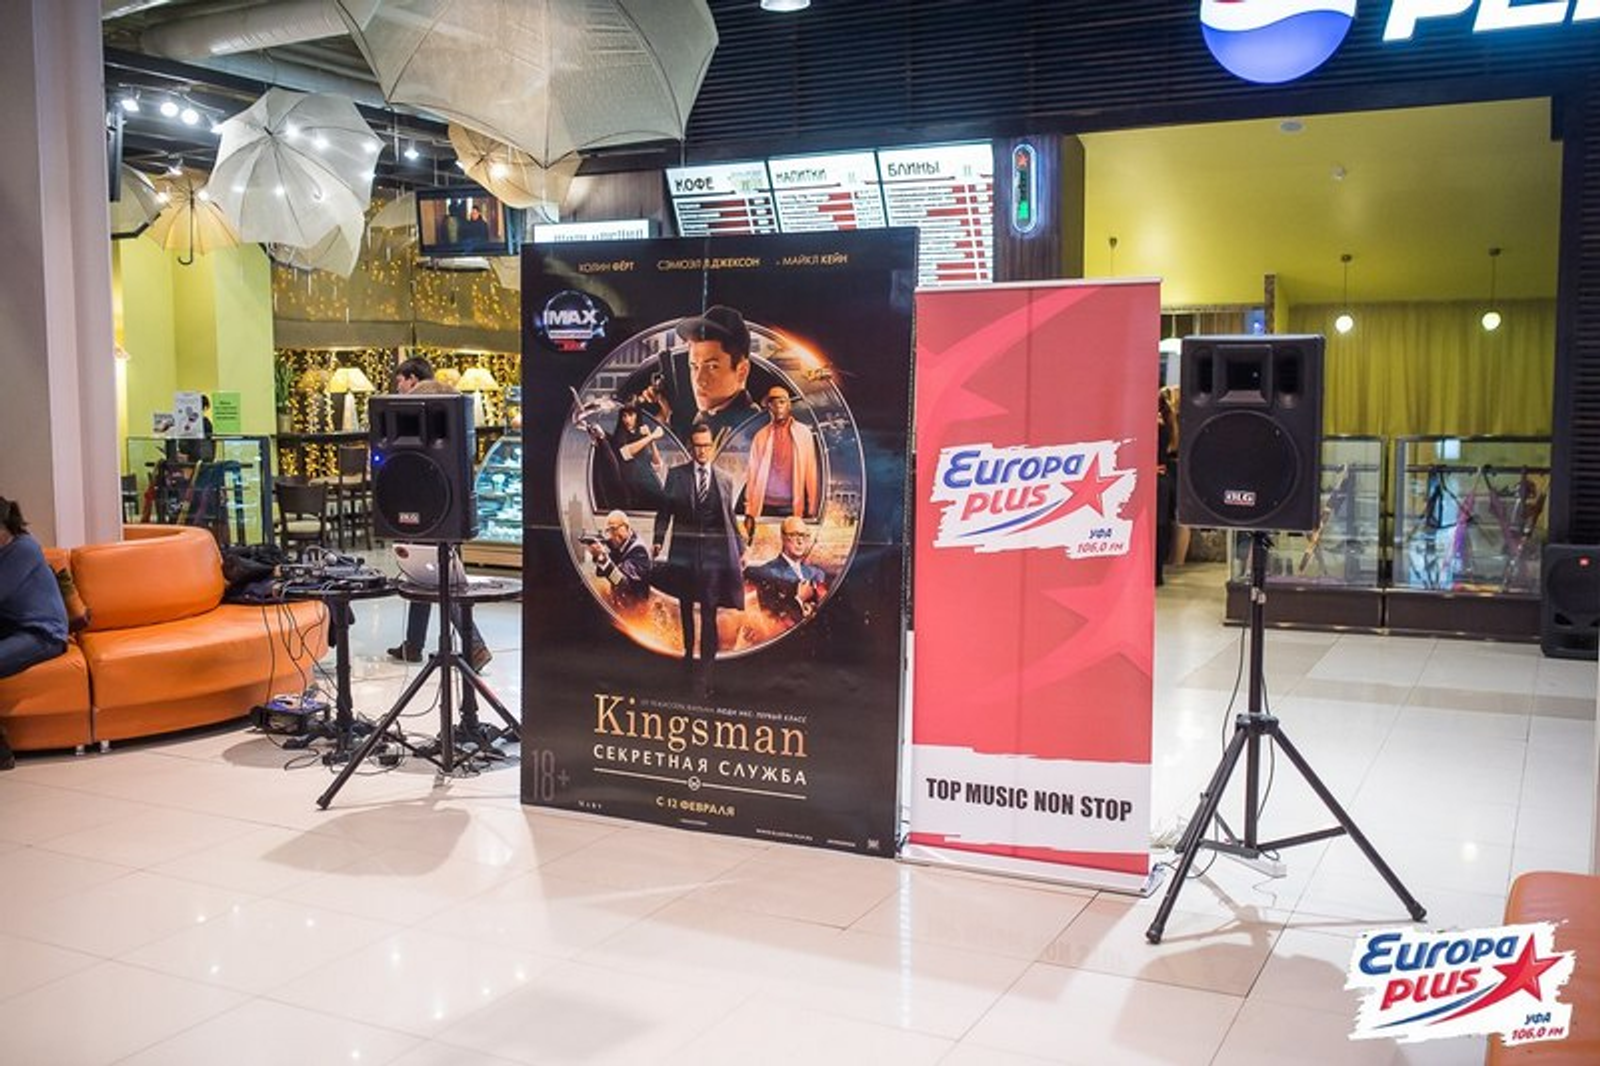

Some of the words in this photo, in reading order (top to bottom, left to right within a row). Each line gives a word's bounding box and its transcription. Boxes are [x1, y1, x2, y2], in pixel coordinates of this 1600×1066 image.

[888, 161, 940, 177] БЛИНЫ
[674, 177, 715, 192] КОФЕ
[782, 255, 819, 266] МАЙКЛ
[820, 252, 848, 265] КЕЙН
[543, 309, 599, 326] IMAX
[943, 450, 1085, 489] Europa
[1109, 541, 1123, 551] FM
[594, 694, 807, 757] Kingsman
[784, 714, 807, 724] КЛАСС
[593, 744, 708, 773] СЕКРЕТНАЯ
[718, 760, 807, 785] СЛУЖБА
[532, 749, 570, 802] 18+
[656, 796, 665, 807] С
[667, 798, 679, 809] 12
[680, 800, 735, 817] ФЕВРАЛЯ
[926, 777, 961, 801] TOP
[966, 783, 1028, 810] MUSIC
[1034, 790, 1074, 816] NON
[1080, 796, 1133, 822] STOP
